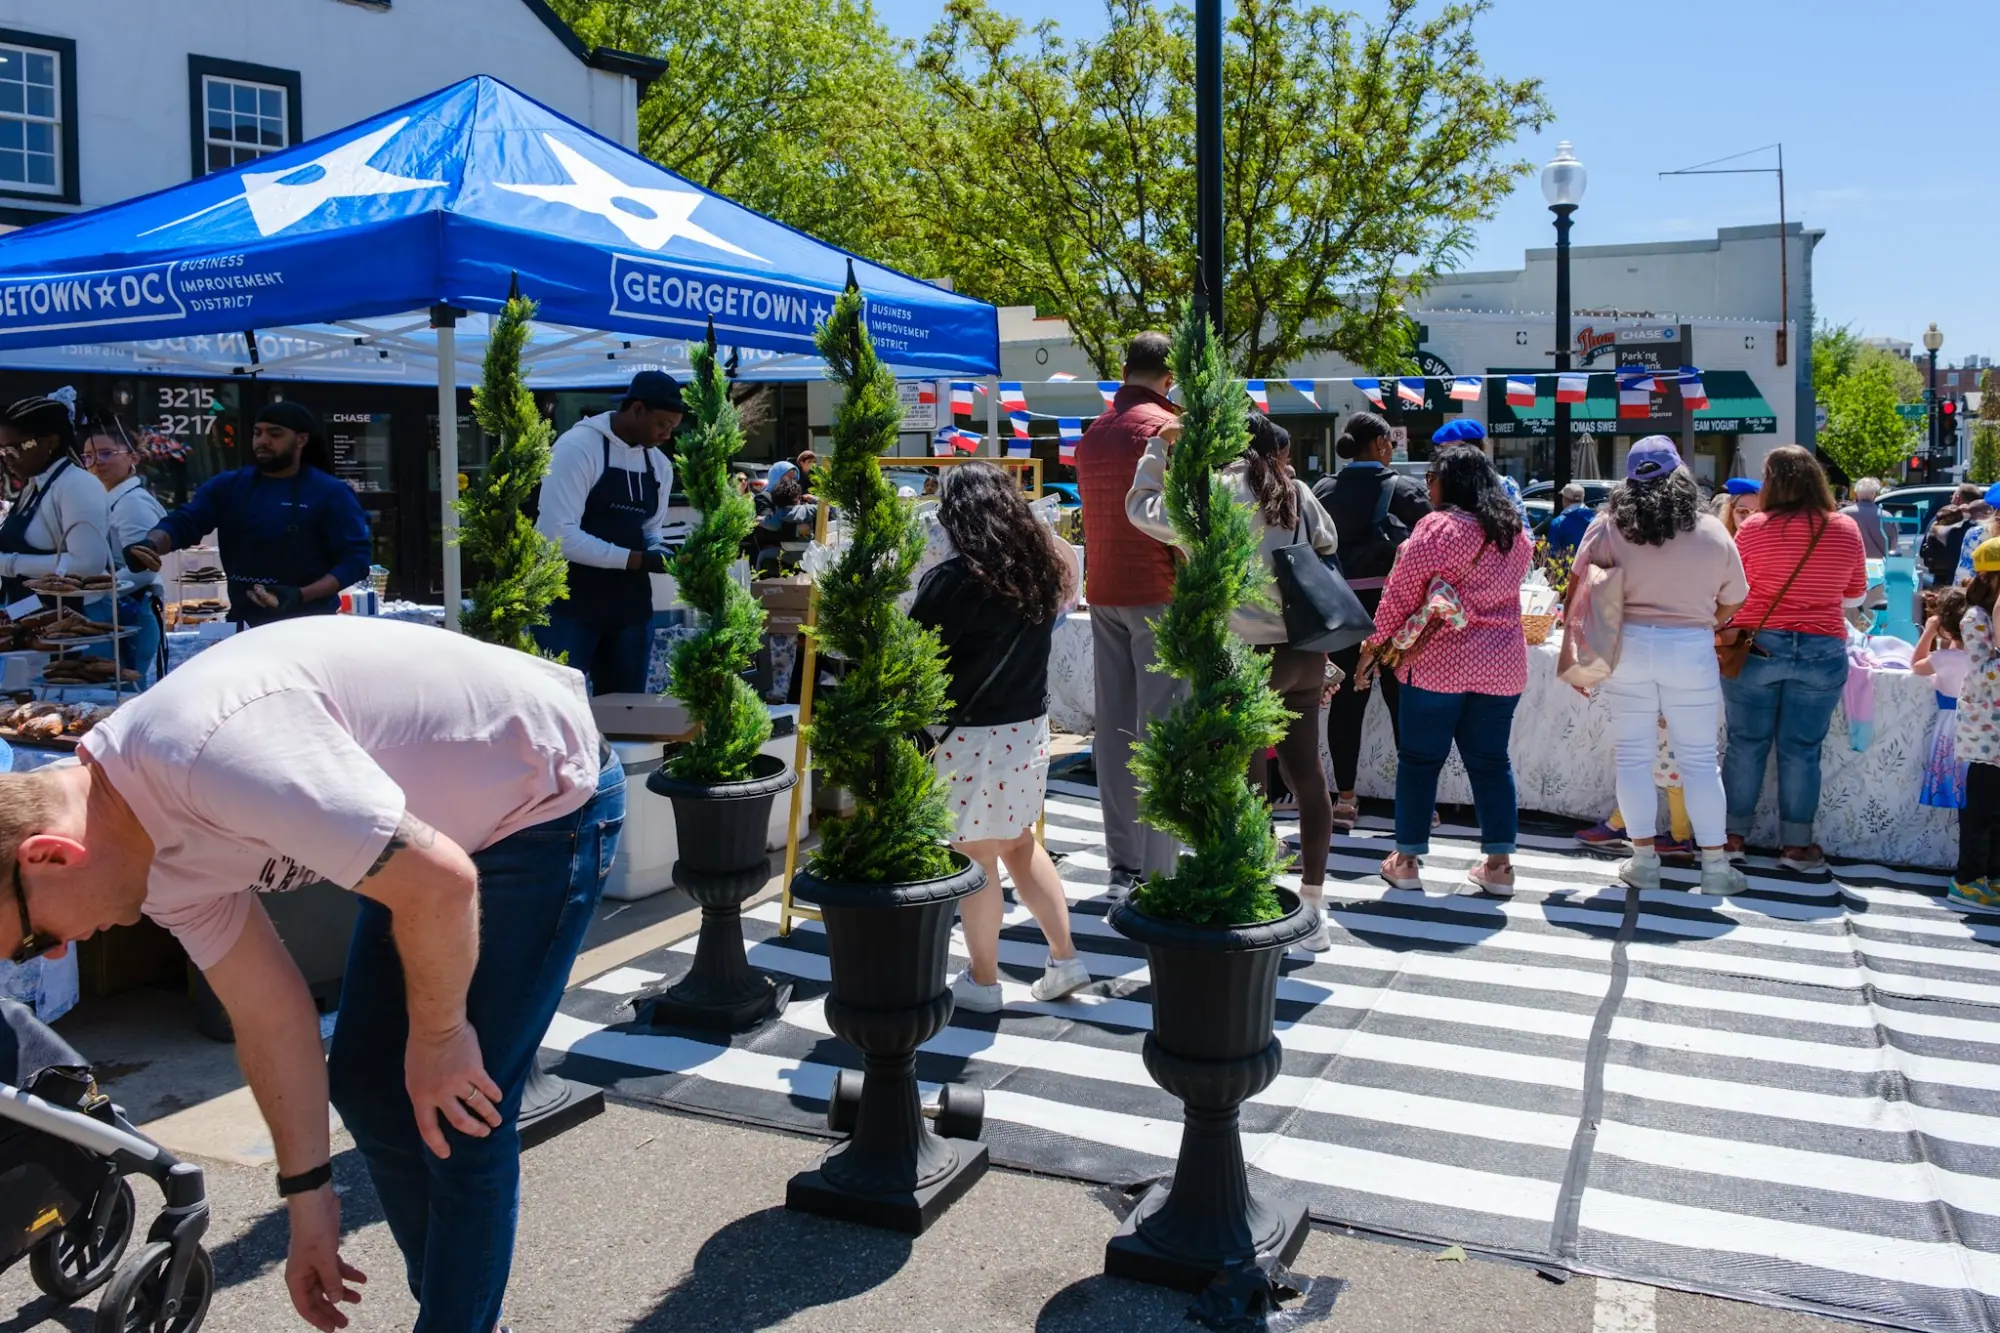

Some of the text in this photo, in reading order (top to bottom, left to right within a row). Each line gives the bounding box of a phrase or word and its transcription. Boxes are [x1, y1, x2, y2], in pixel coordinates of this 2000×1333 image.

[180, 254, 245, 272] BUSINESS
[180, 272, 284, 293] IMPROVEMENT
[0, 272, 165, 316] ETOWN DC
[622, 271, 807, 325] GEORGETOWN
[190, 295, 254, 312] DISTRICT
[872, 304, 912, 320] BUSINESS
[872, 320, 930, 339] IMPROVEMENT
[1621, 330, 1662, 340] CHASE
[872, 337, 909, 351] DISTRICT
[1577, 327, 1615, 356] Thom
[1621, 352, 1658, 362] Parkng
[158, 387, 215, 409] 3215
[159, 414, 218, 435] 3217
[333, 413, 371, 423] CHASE
[1694, 420, 1739, 431] EAM YOGURT
[1495, 422, 1515, 433] SWEET
[1570, 421, 1596, 433] OMAS
